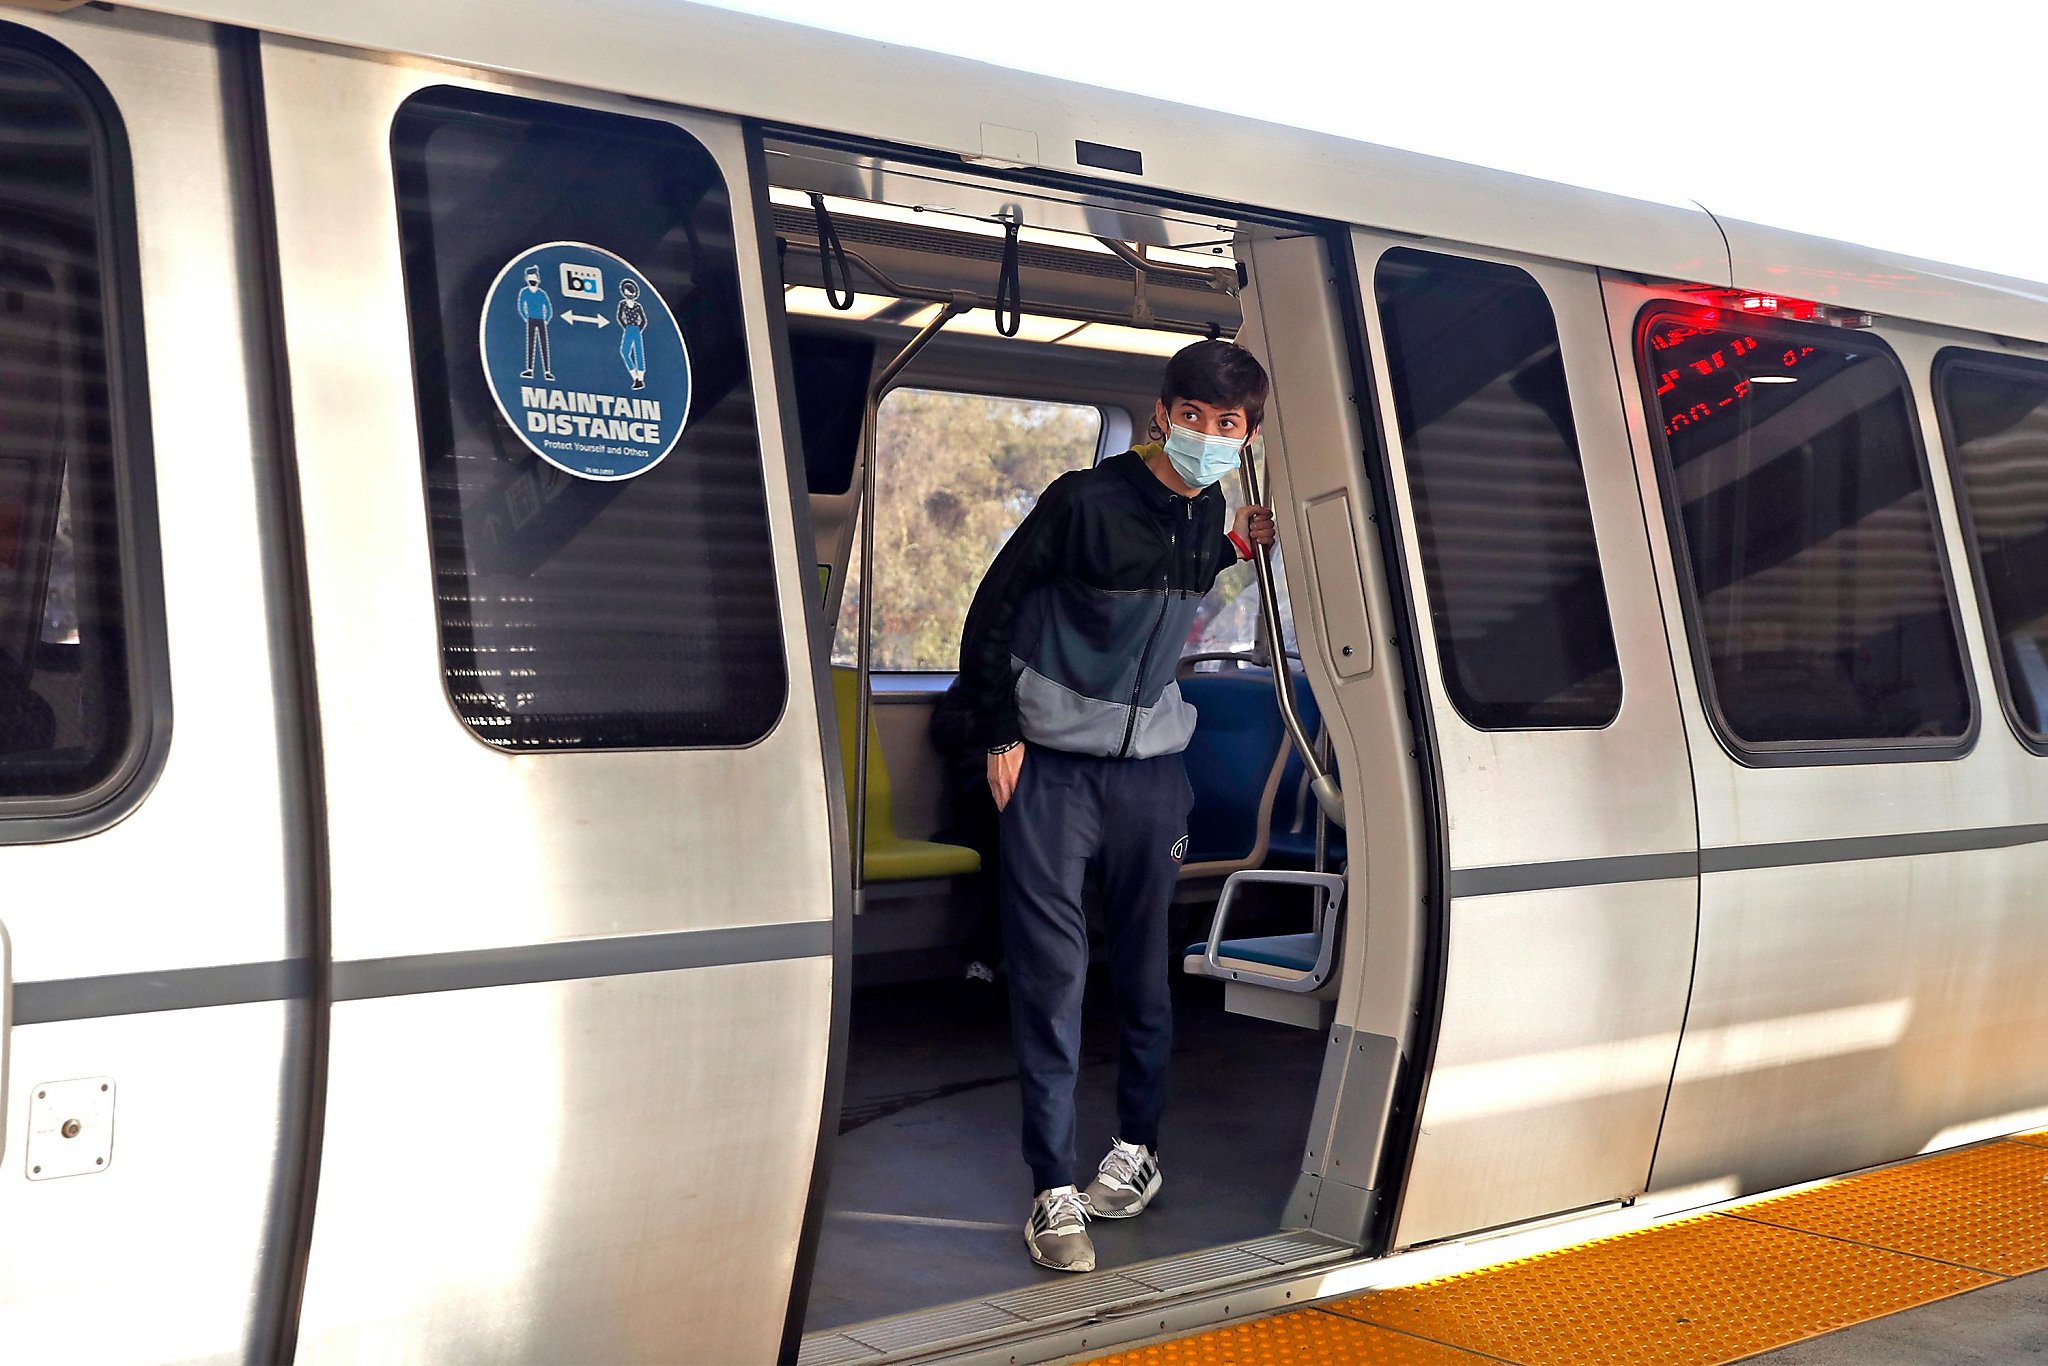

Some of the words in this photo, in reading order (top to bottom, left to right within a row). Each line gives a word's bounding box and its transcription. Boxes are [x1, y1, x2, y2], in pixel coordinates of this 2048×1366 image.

[521, 386, 661, 421] MAINTAIN
[526, 411, 661, 444] DISTANCE
[543, 439, 573, 450] Protect
[574, 442, 605, 453] Yourself
[606, 446, 622, 455] and
[623, 447, 649, 457] Others
